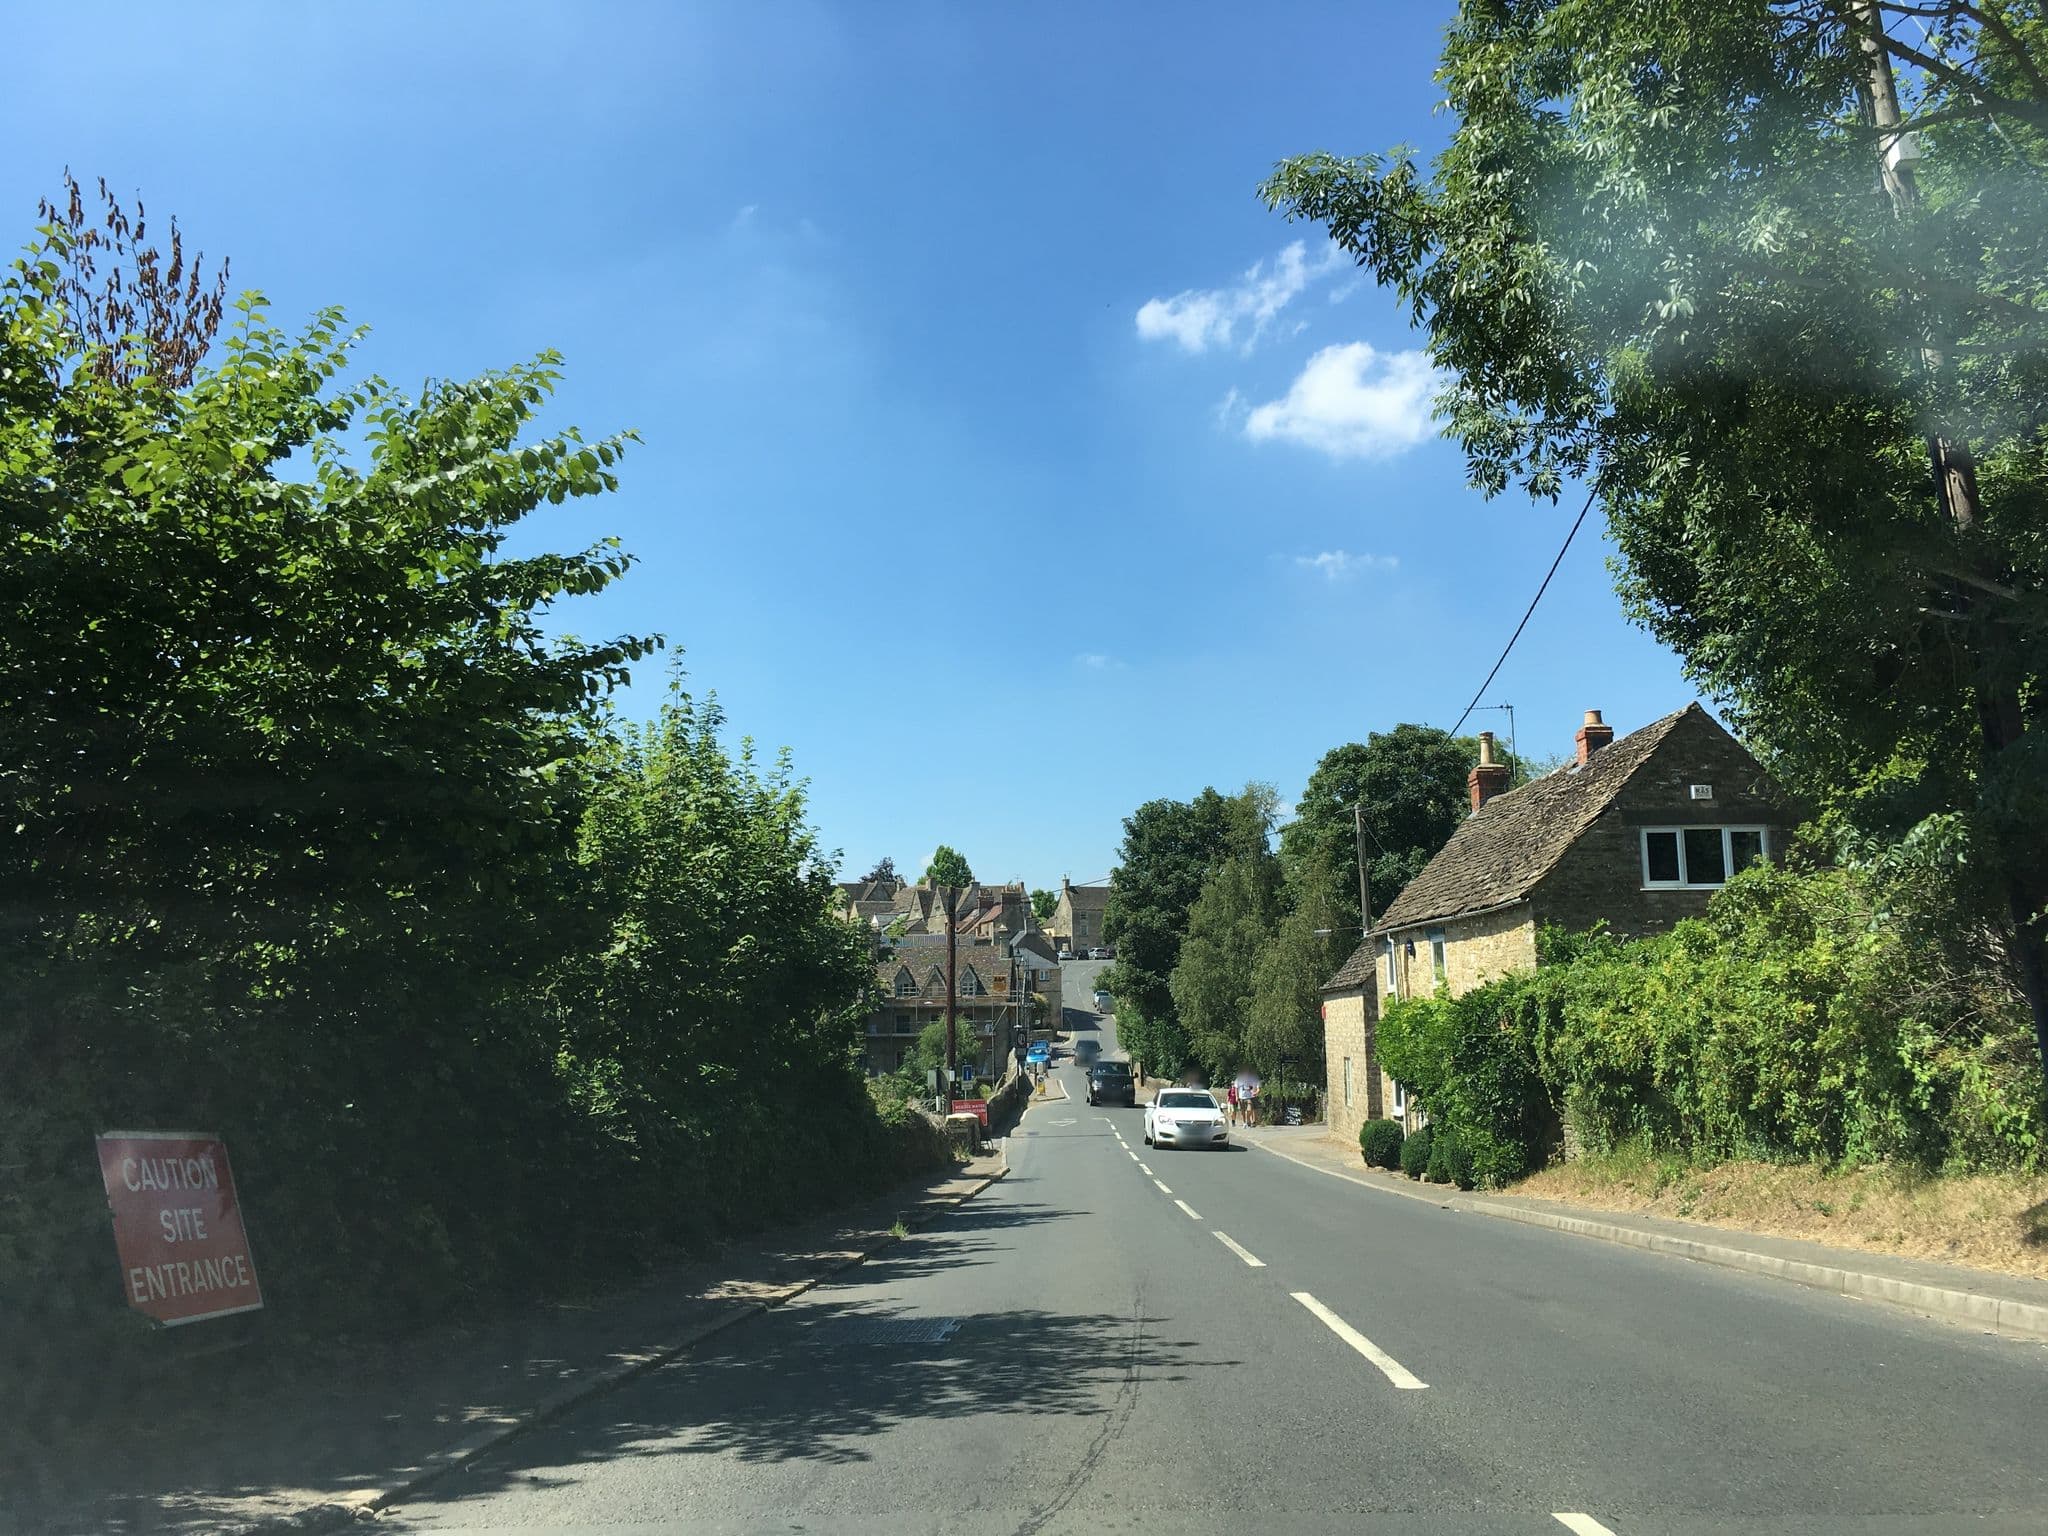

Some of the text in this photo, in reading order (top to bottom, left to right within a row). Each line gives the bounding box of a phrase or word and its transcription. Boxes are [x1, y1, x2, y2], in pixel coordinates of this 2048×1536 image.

[122, 1157, 219, 1192] CAUTION
[159, 1208, 208, 1243] SITE
[129, 1255, 250, 1303] ENTRANCE
